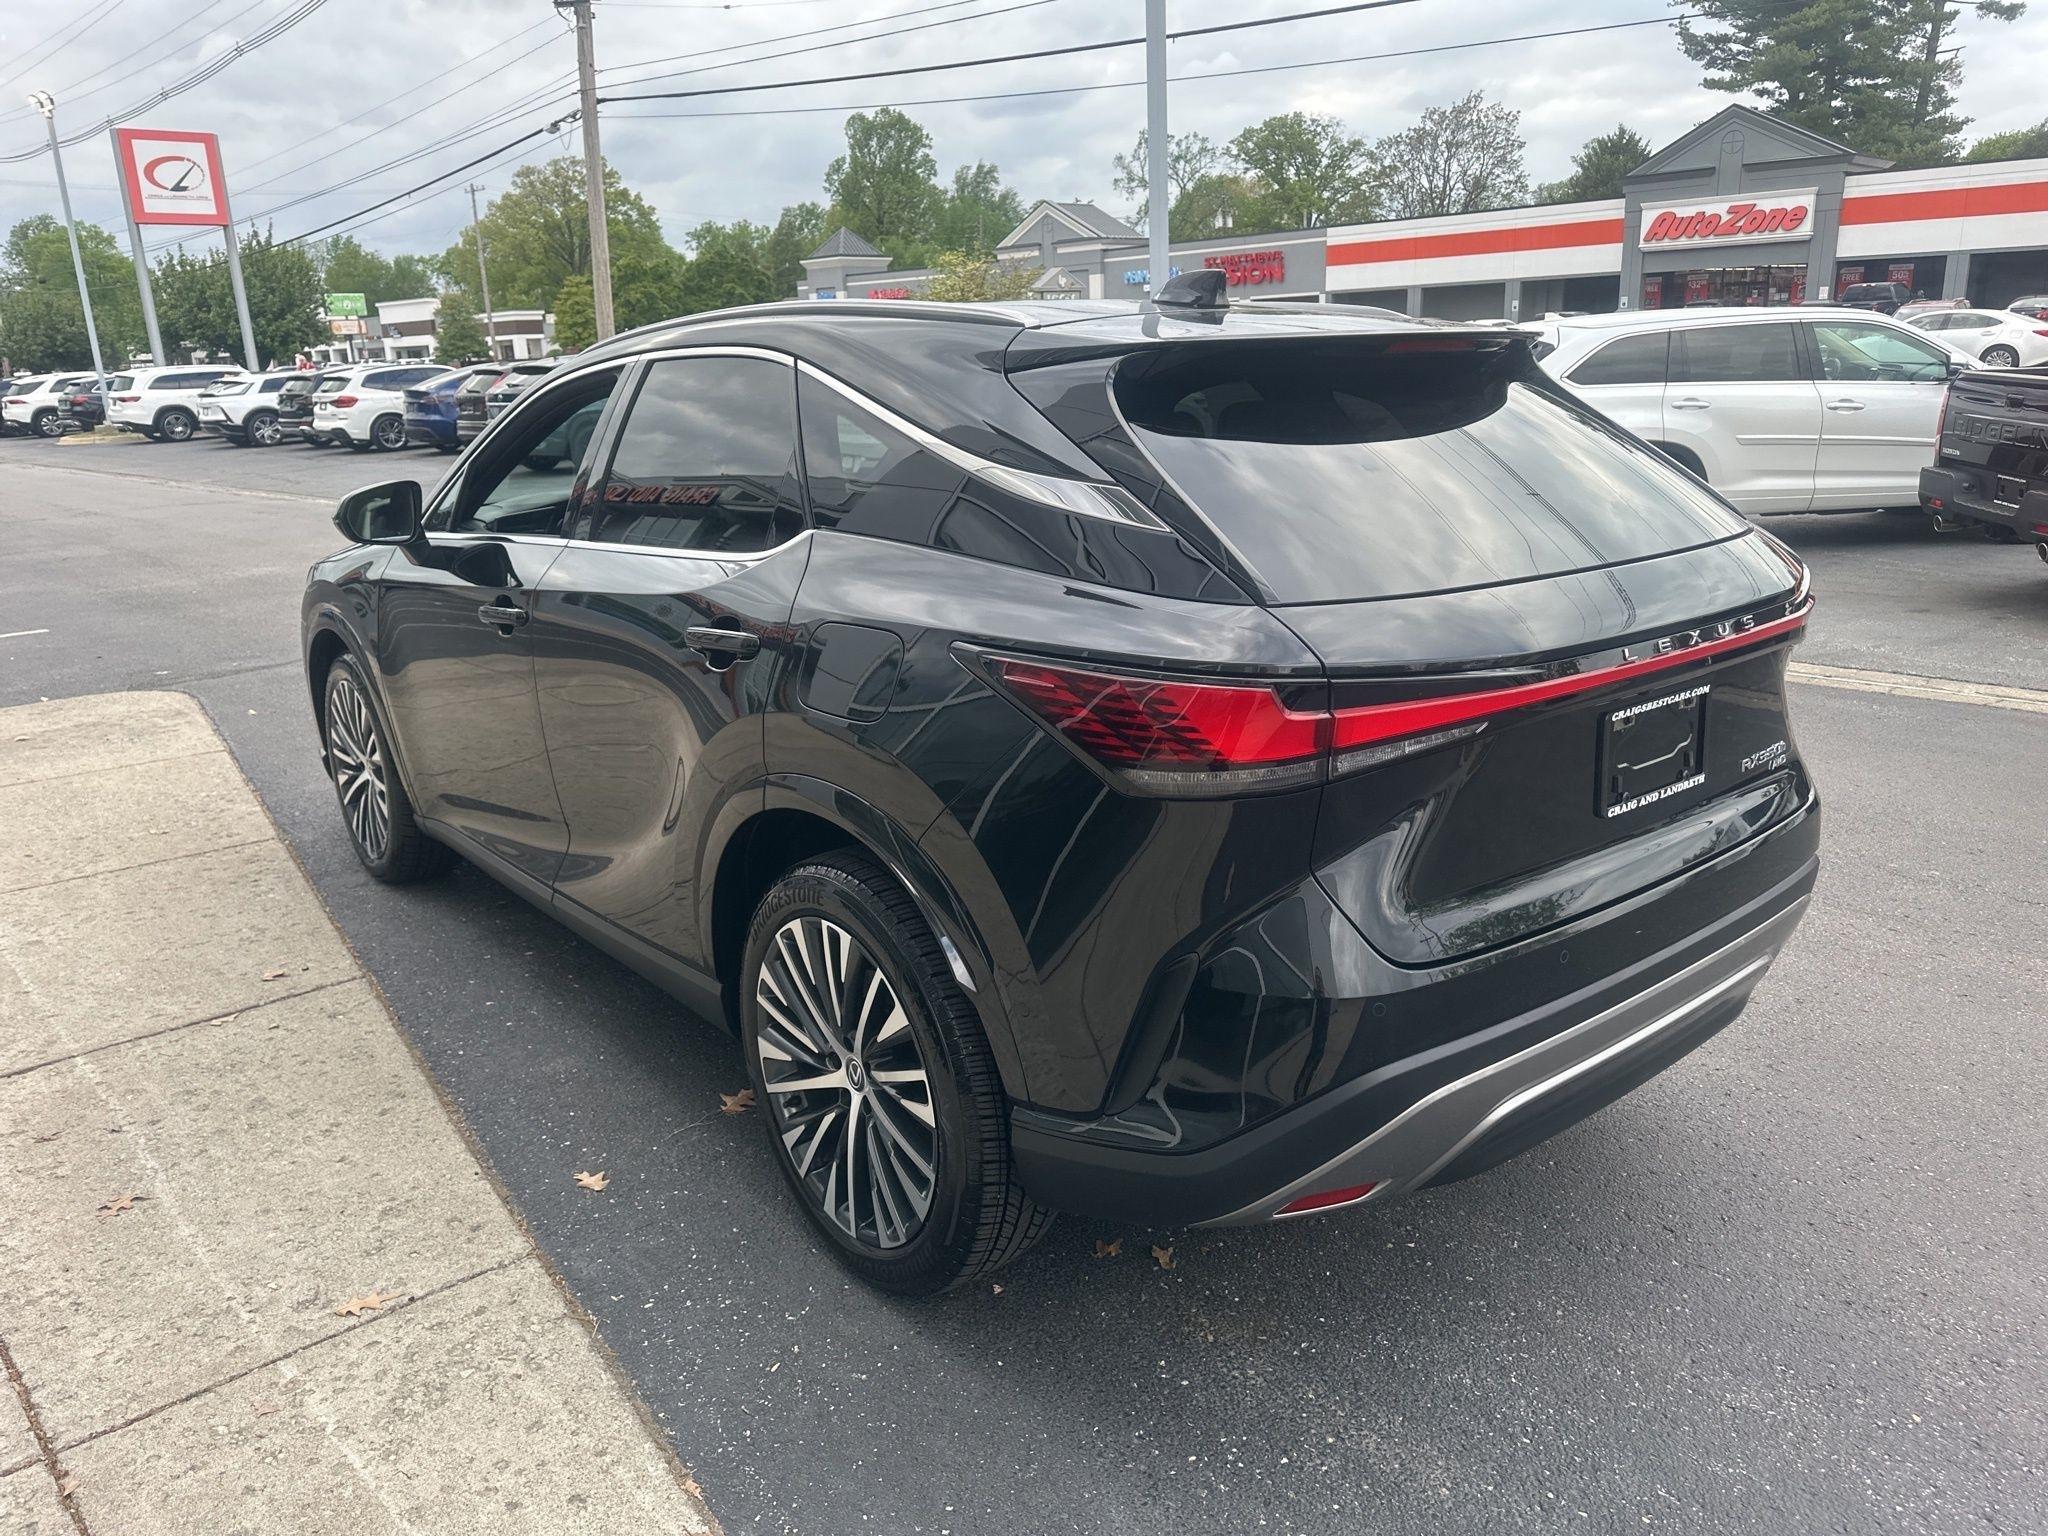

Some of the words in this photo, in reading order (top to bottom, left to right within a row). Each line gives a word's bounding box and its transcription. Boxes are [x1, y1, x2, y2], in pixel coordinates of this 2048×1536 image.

[1643, 203, 1808, 241] AutoZone
[1842, 273, 1861, 281] FREE
[1622, 615, 1755, 661] LEXUS
[1611, 685, 1711, 722] CRAIGSBESTCARS.COM
[1607, 800, 1638, 818] CRAIG
[1639, 791, 1660, 807] AND
[1660, 773, 1706, 799] LANDRETH
